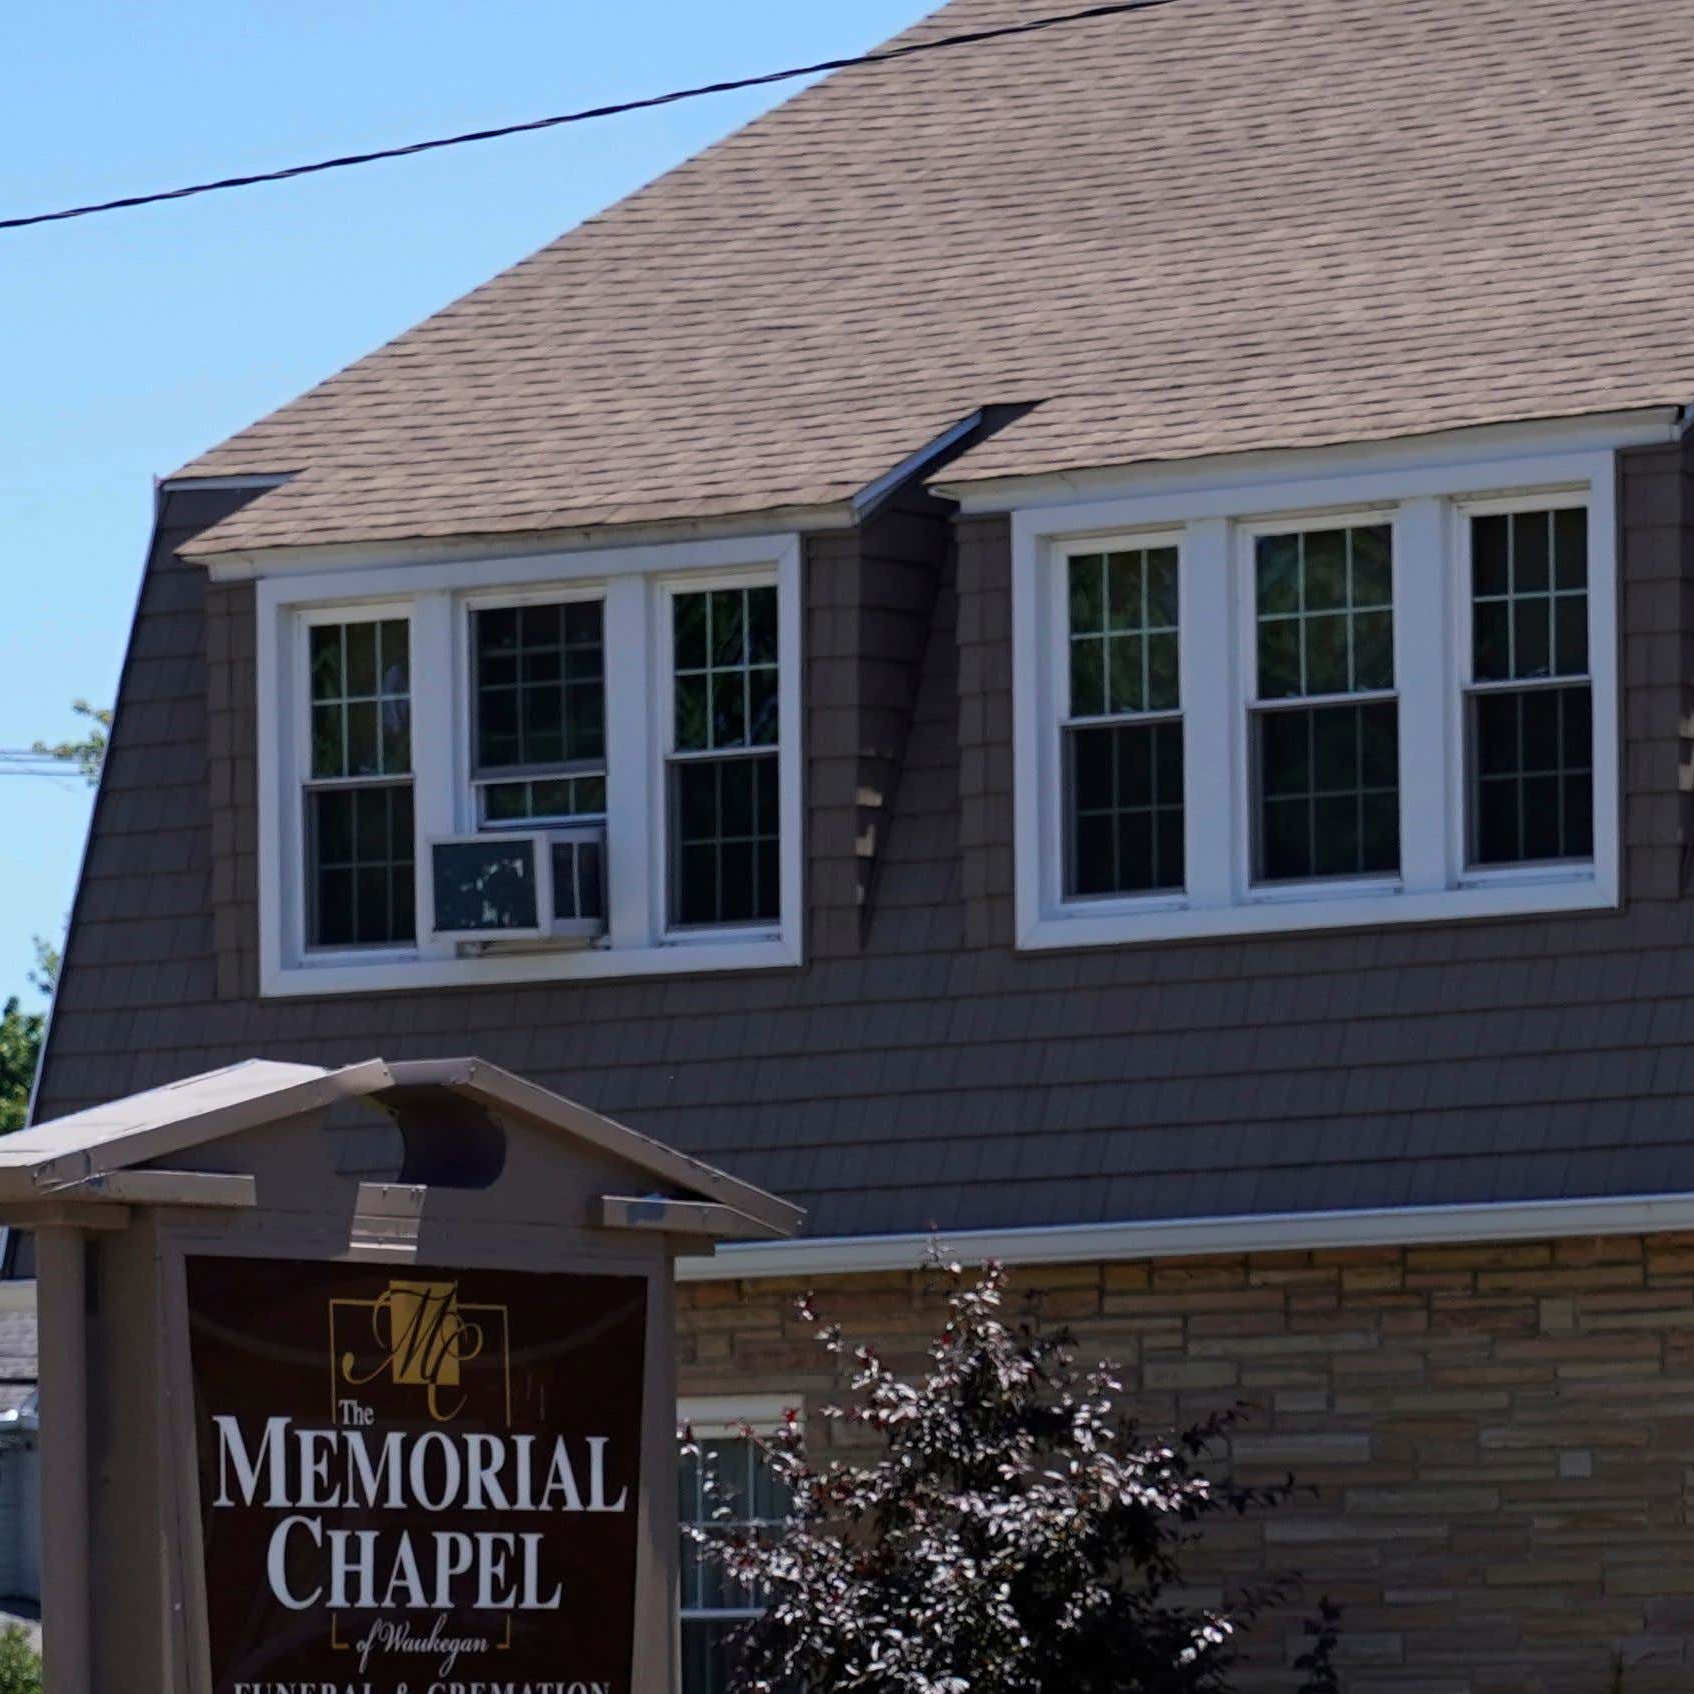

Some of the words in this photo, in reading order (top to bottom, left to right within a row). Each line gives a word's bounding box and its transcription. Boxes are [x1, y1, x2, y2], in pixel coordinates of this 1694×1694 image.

[339, 1399, 375, 1425] The
[212, 1415, 628, 1513] MEMORIAL
[267, 1515, 562, 1610] CHAPEL
[356, 1617, 382, 1674] of
[380, 1614, 488, 1677] Waukegan
